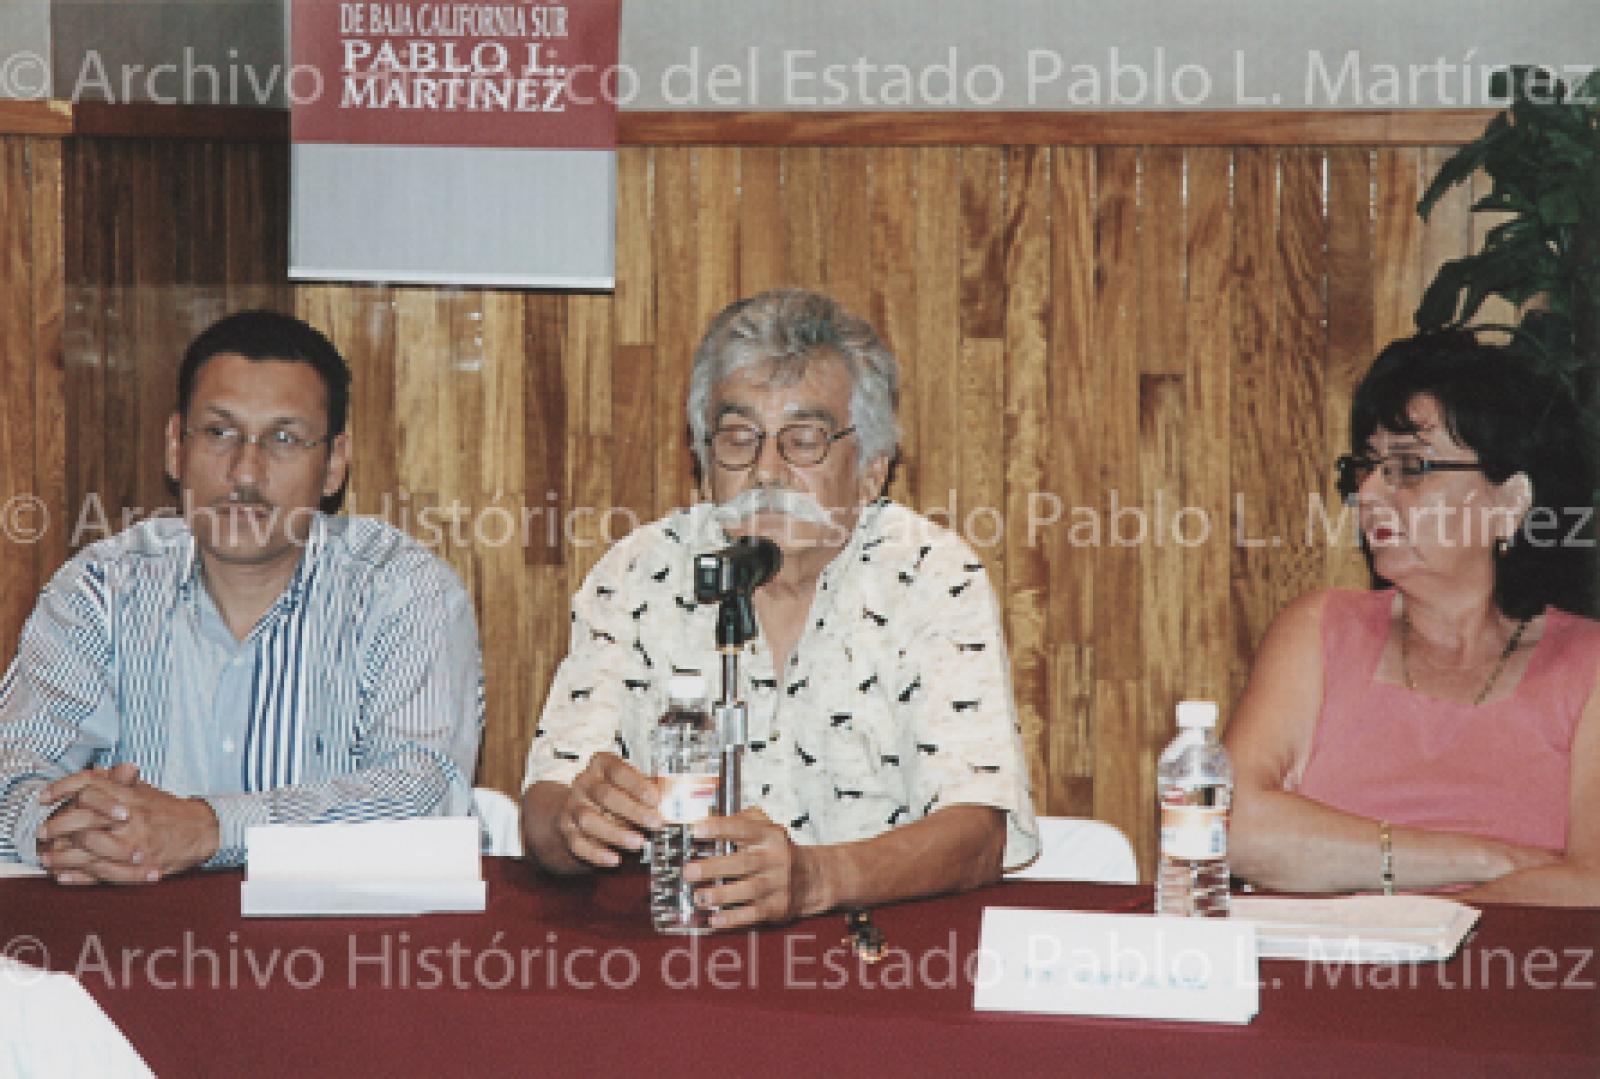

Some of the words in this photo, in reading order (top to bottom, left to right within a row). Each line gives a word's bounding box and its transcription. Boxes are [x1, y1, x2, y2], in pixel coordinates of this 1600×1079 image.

[340, 3, 365, 34] DE
[369, 3, 414, 36] BAJA
[416, 4, 526, 37] CALIFORNIA
[530, 6, 569, 37] SUR
[340, 40, 508, 73] PABLO
[523, 42, 566, 73] L.
